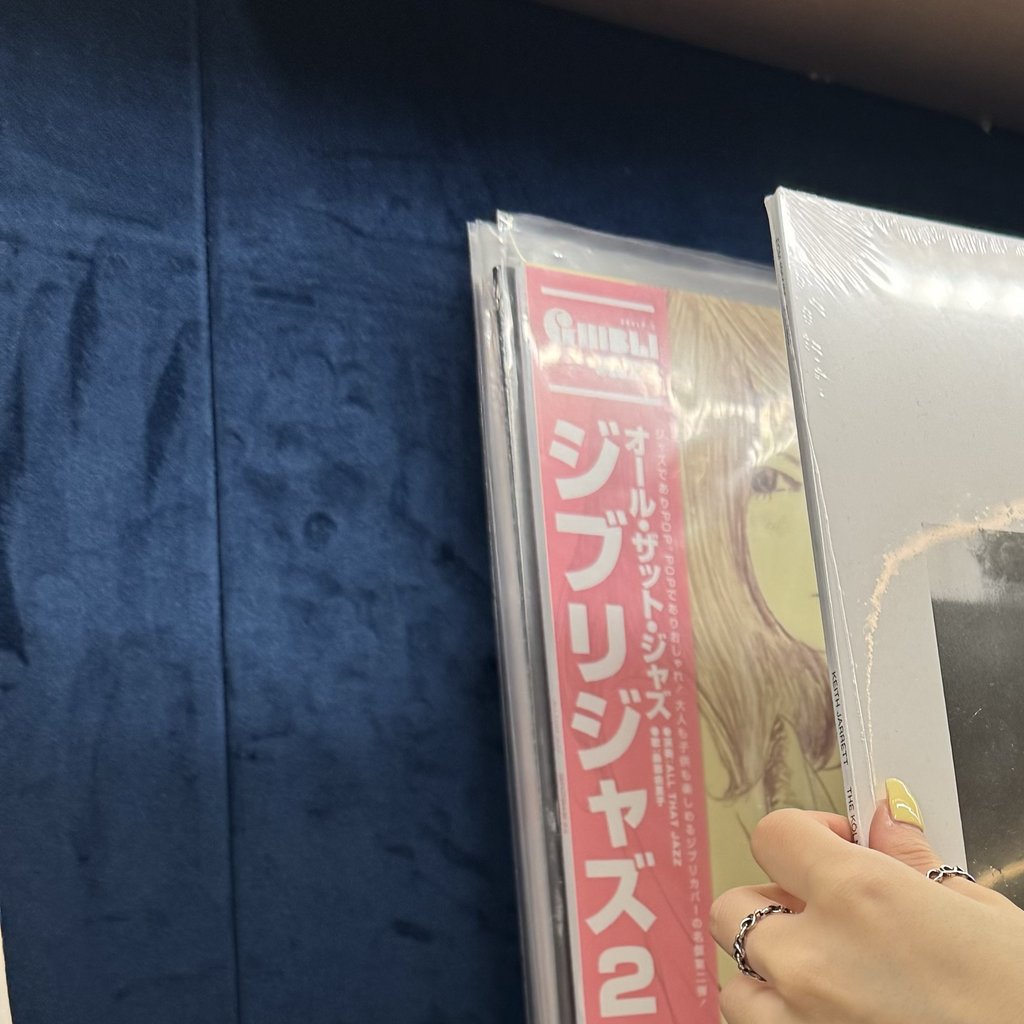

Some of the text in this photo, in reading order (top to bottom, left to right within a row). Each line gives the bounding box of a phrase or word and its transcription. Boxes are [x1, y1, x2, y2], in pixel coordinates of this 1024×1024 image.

[549, 419, 657, 1018] ジブリジャズ2
[832, 671, 841, 708] KEITH
[837, 711, 849, 766] JARRETT
[846, 787, 855, 811] THE
